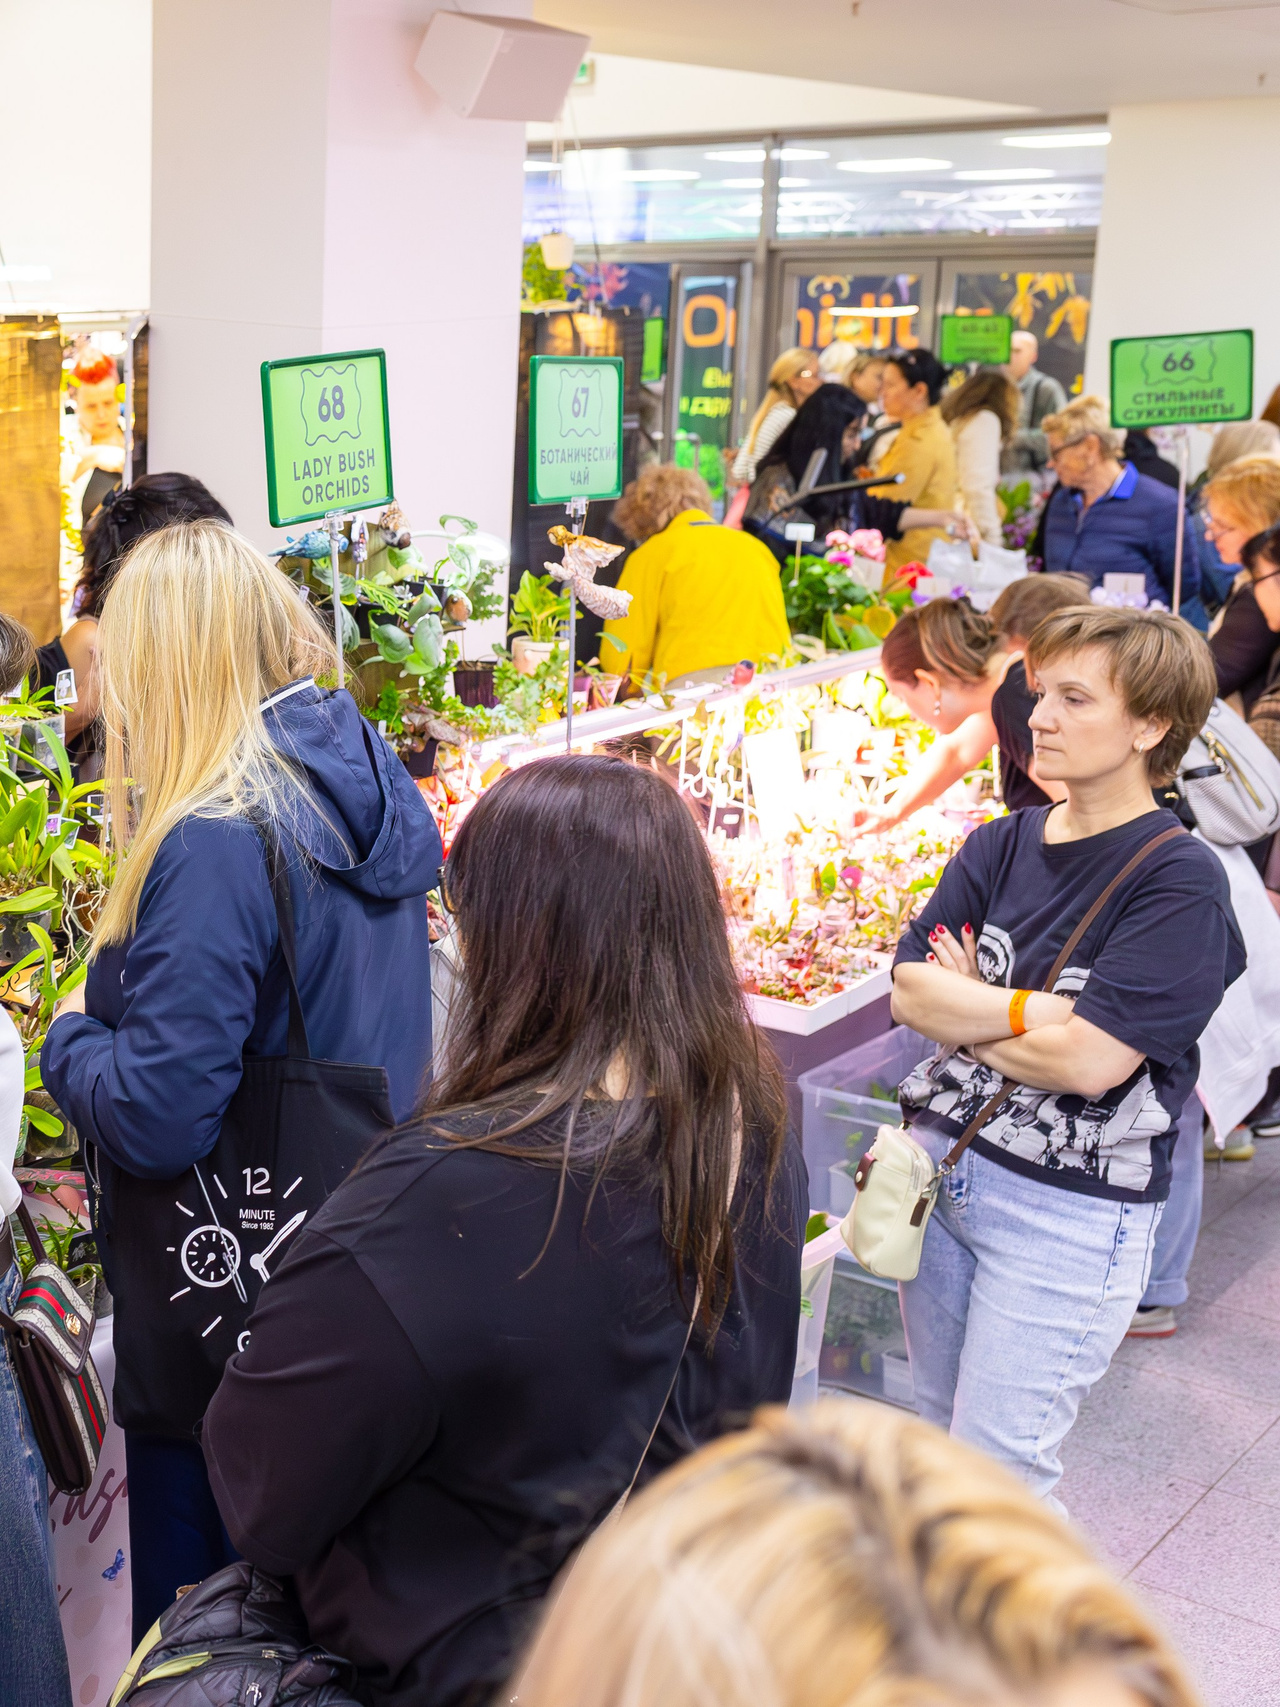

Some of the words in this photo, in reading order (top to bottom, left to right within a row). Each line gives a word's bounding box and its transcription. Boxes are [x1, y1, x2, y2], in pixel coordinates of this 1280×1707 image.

[1162, 351, 1195, 372] 66
[318, 385, 345, 422] 68
[572, 387, 589, 418] 67
[1132, 387, 1225, 406] СТИЛЬНЫЕ
[1122, 402, 1236, 421] СУККУЛЕНТЫ
[540, 443, 618, 465] БОТАНИЧЕСКИЙ
[293, 455, 332, 482] LADY
[338, 448, 375, 473] BUSH
[570, 466, 590, 486] ЧАЙ
[302, 475, 370, 505] ORCHIDS
[242, 1167, 271, 1196] 12
[239, 1208, 276, 1221] MINUTE
[241, 1221, 258, 1230] Since
[259, 1222, 274, 1231] 1982
